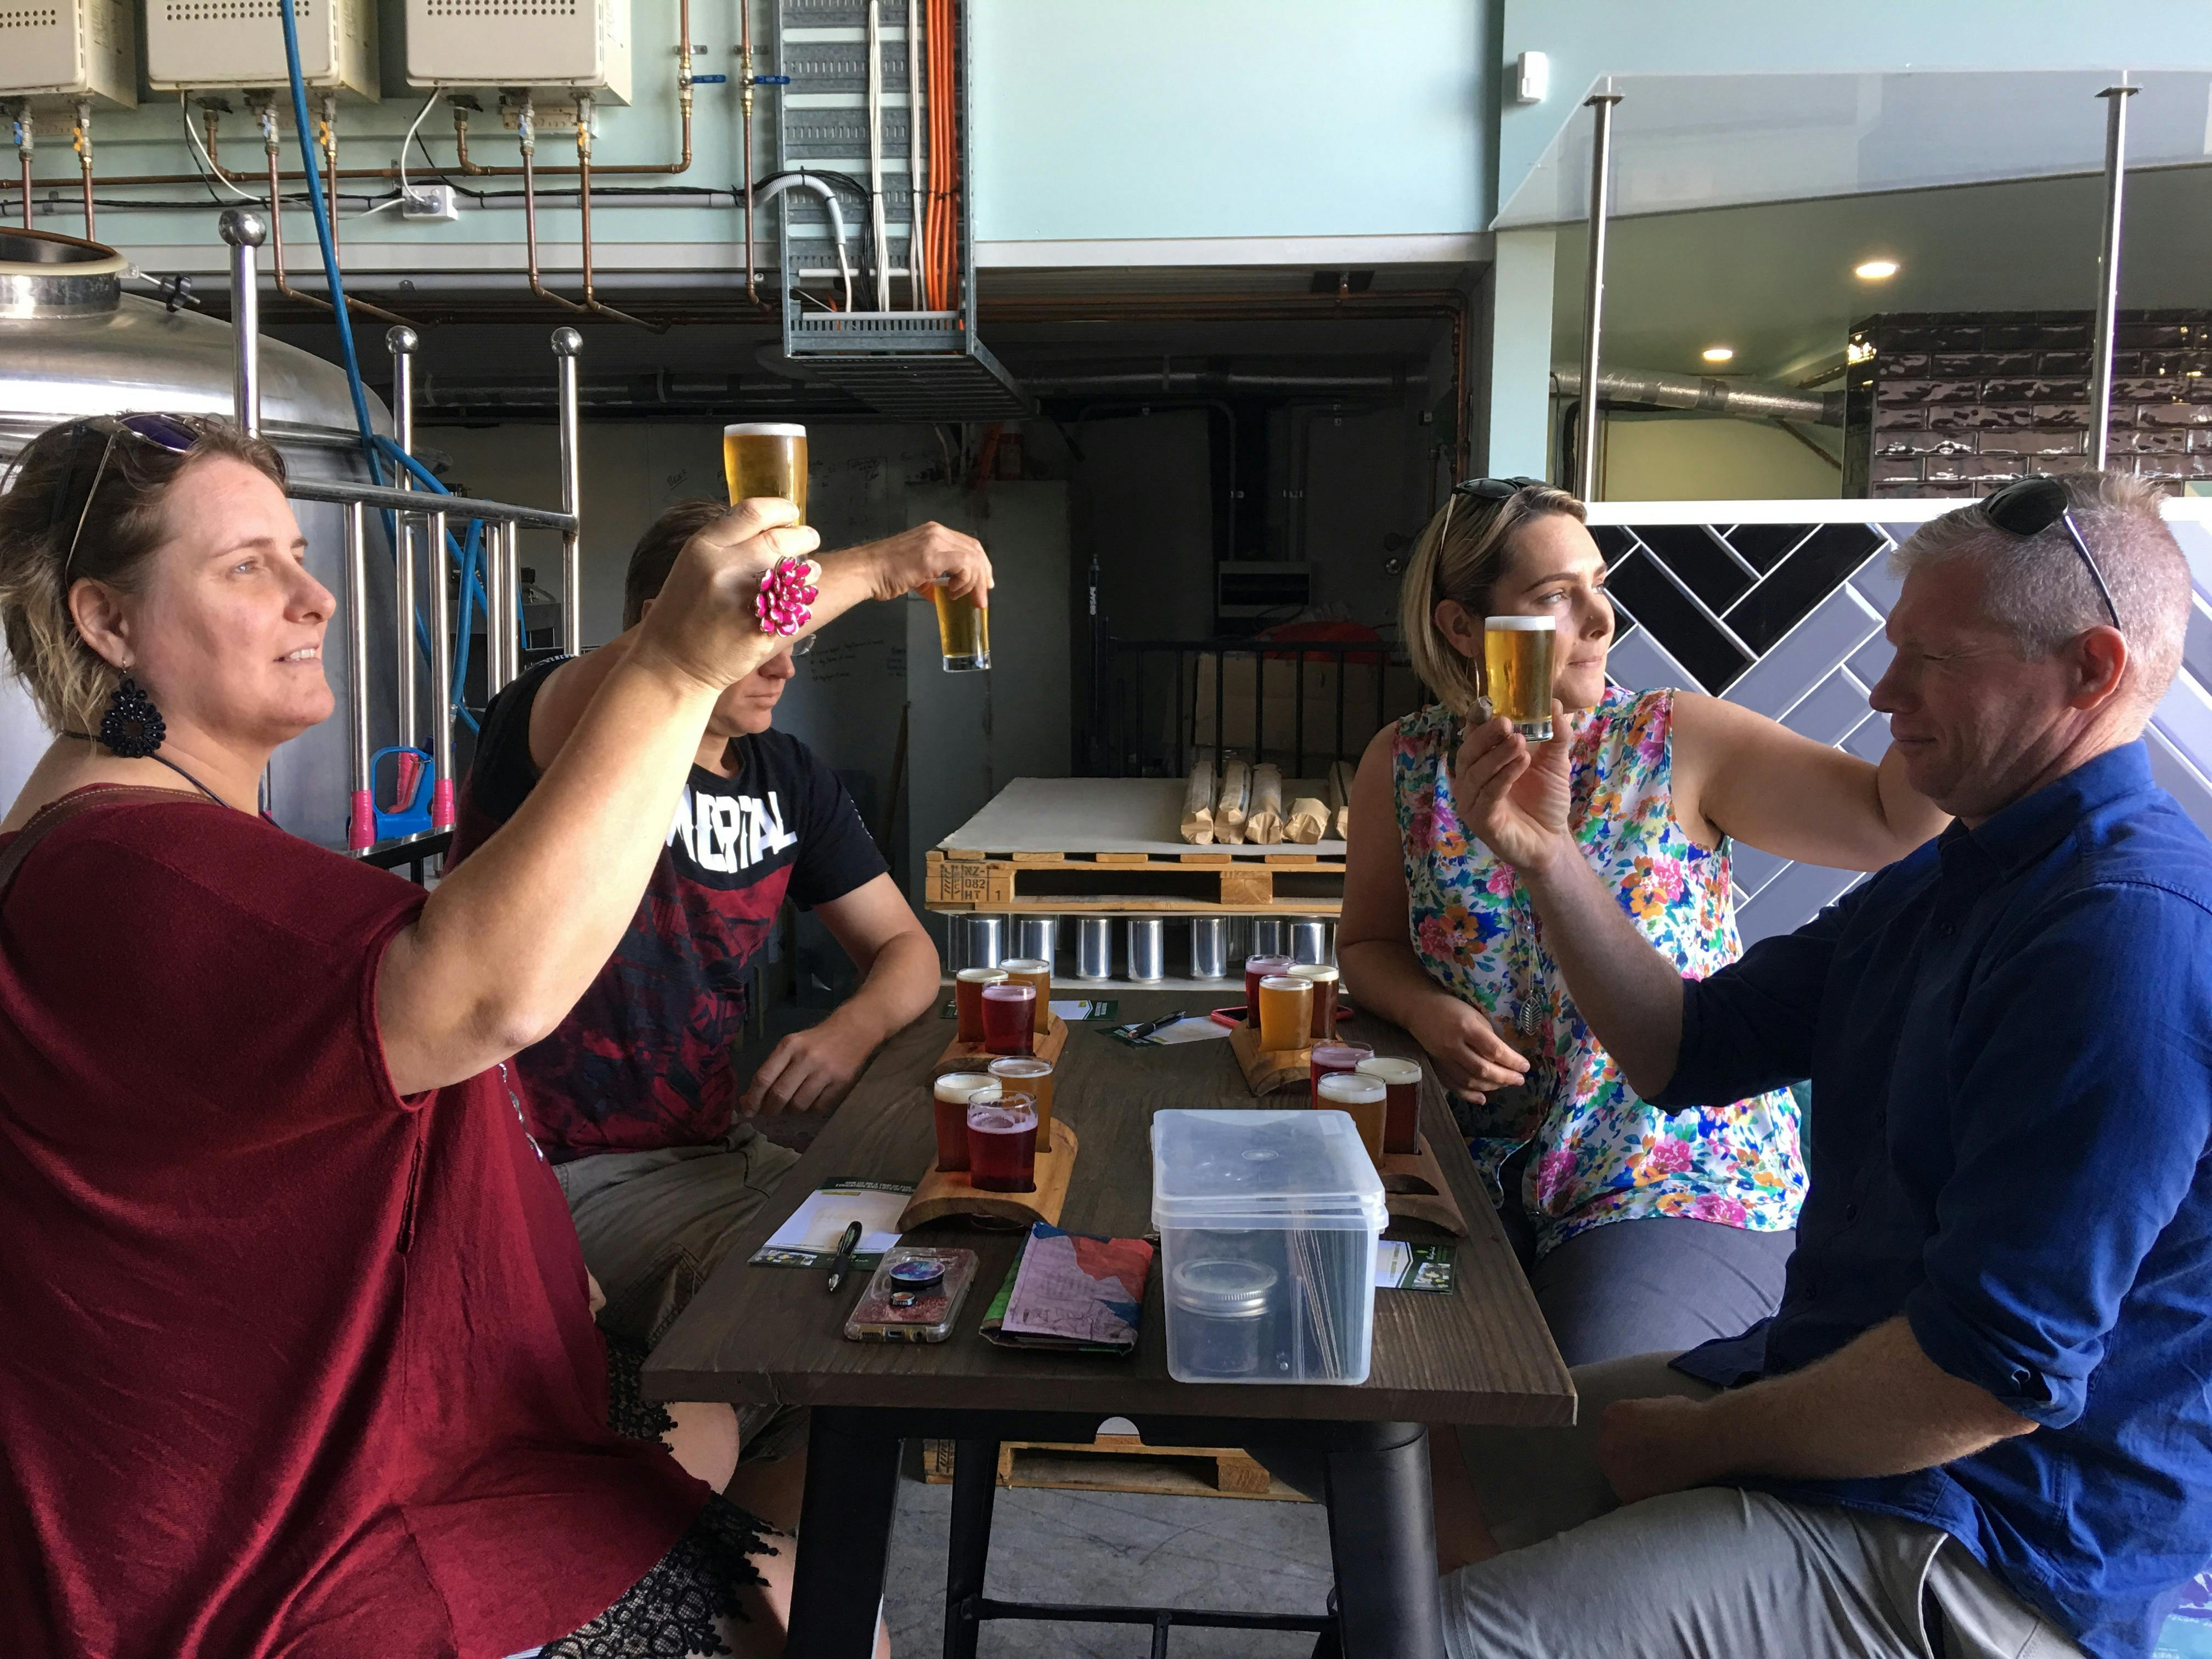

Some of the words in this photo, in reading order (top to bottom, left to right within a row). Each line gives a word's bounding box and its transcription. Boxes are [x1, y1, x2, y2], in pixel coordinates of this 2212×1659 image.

[965, 879, 985, 889] 082
[964, 890, 980, 900] HT
[995, 890, 1001, 901] 1
